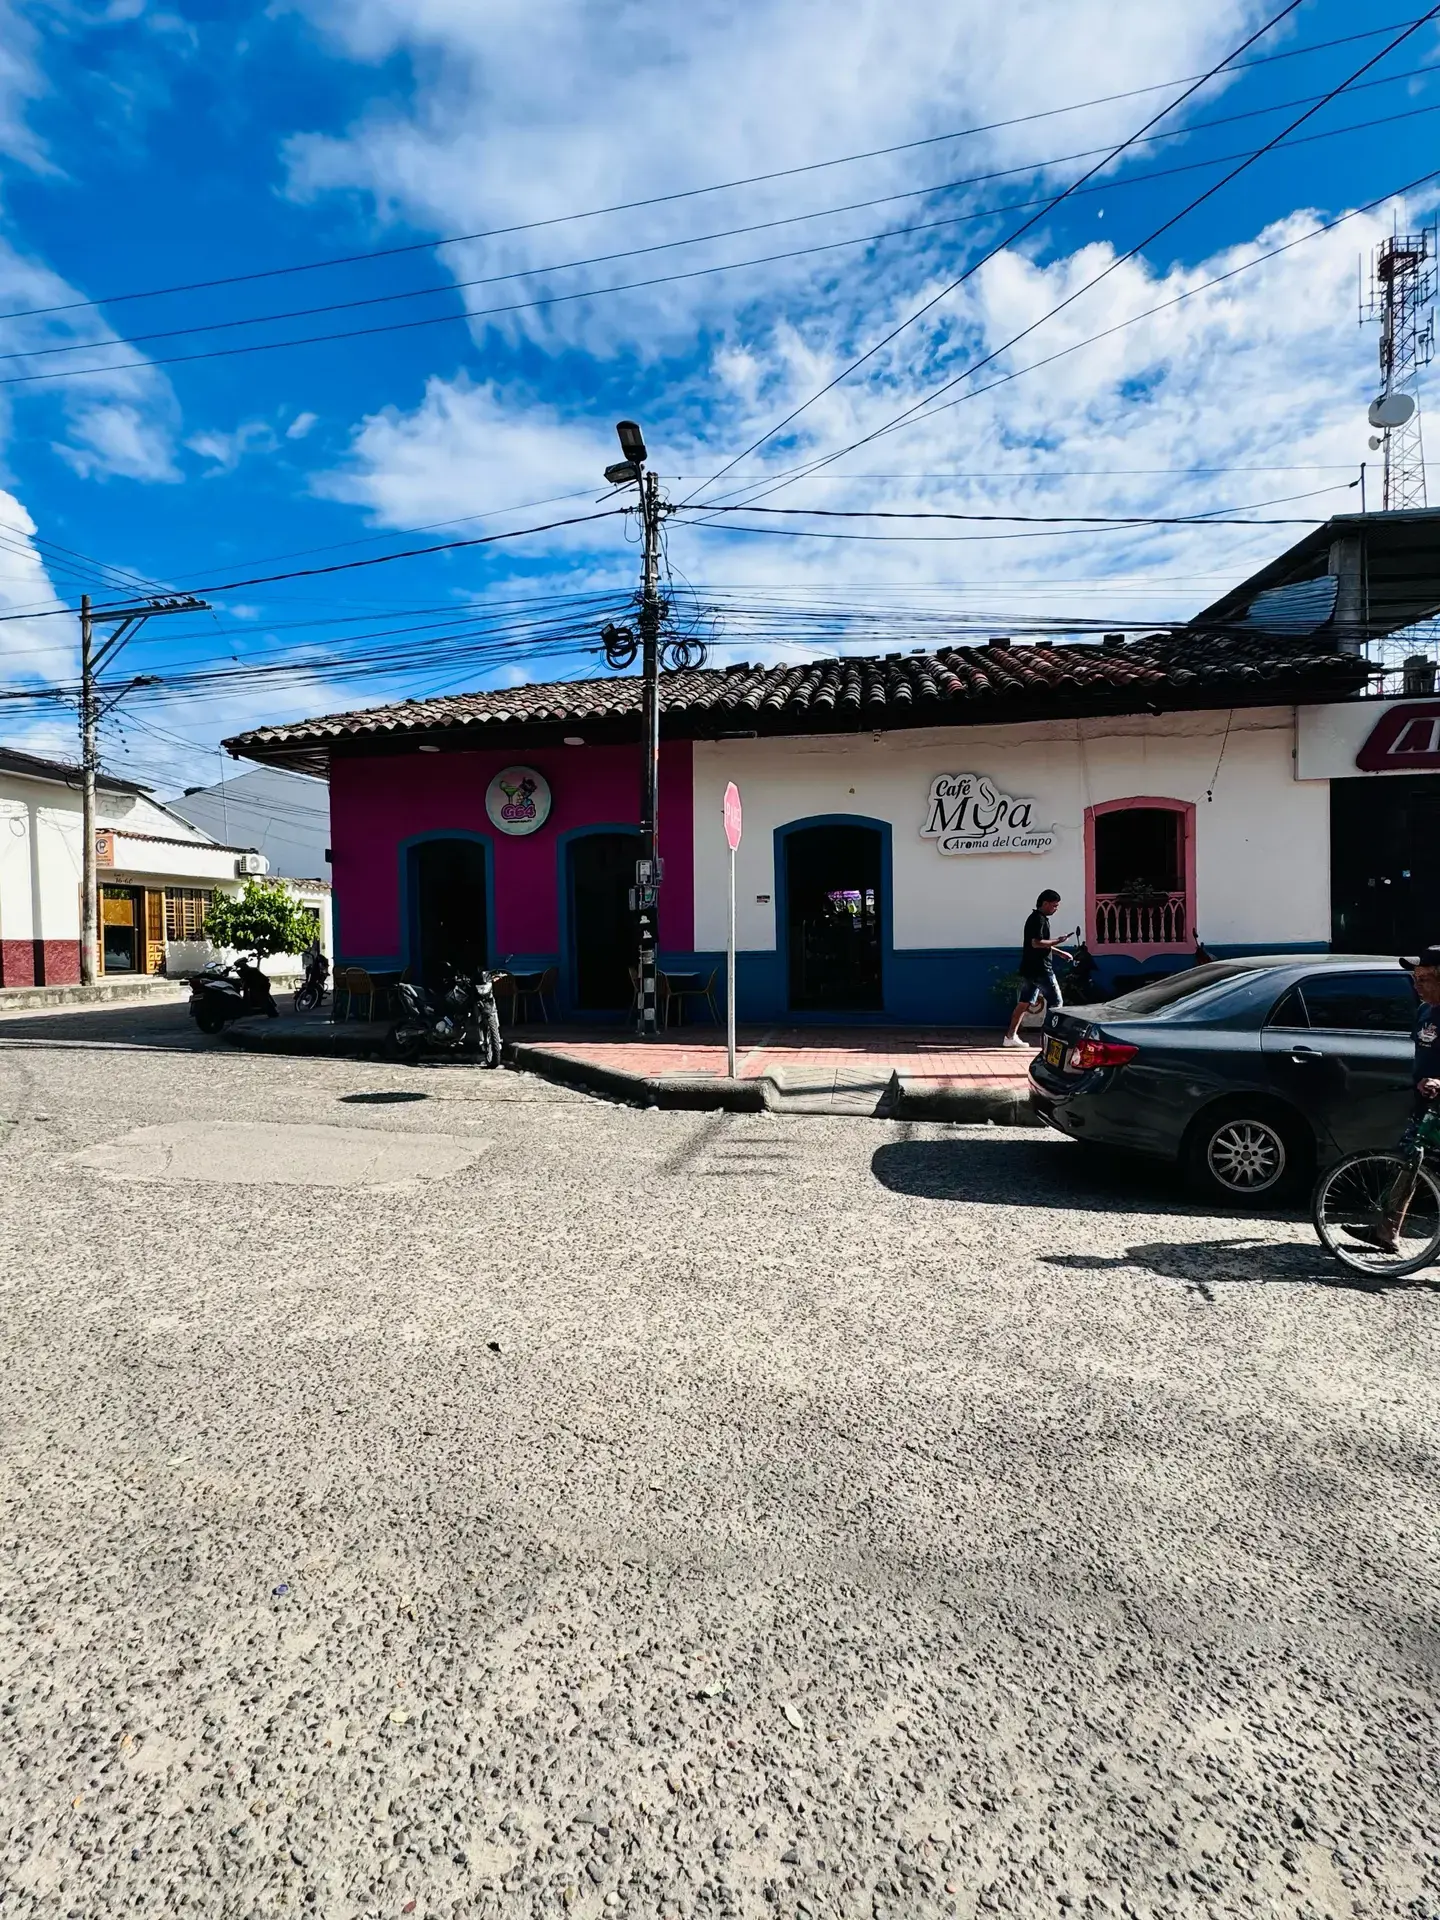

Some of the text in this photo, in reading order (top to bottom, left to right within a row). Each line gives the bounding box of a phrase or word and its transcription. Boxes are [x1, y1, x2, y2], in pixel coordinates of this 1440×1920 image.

[936, 779, 971, 799] Café
[501, 804, 536, 819] G64
[951, 836, 1052, 850] Aroma del Campo
